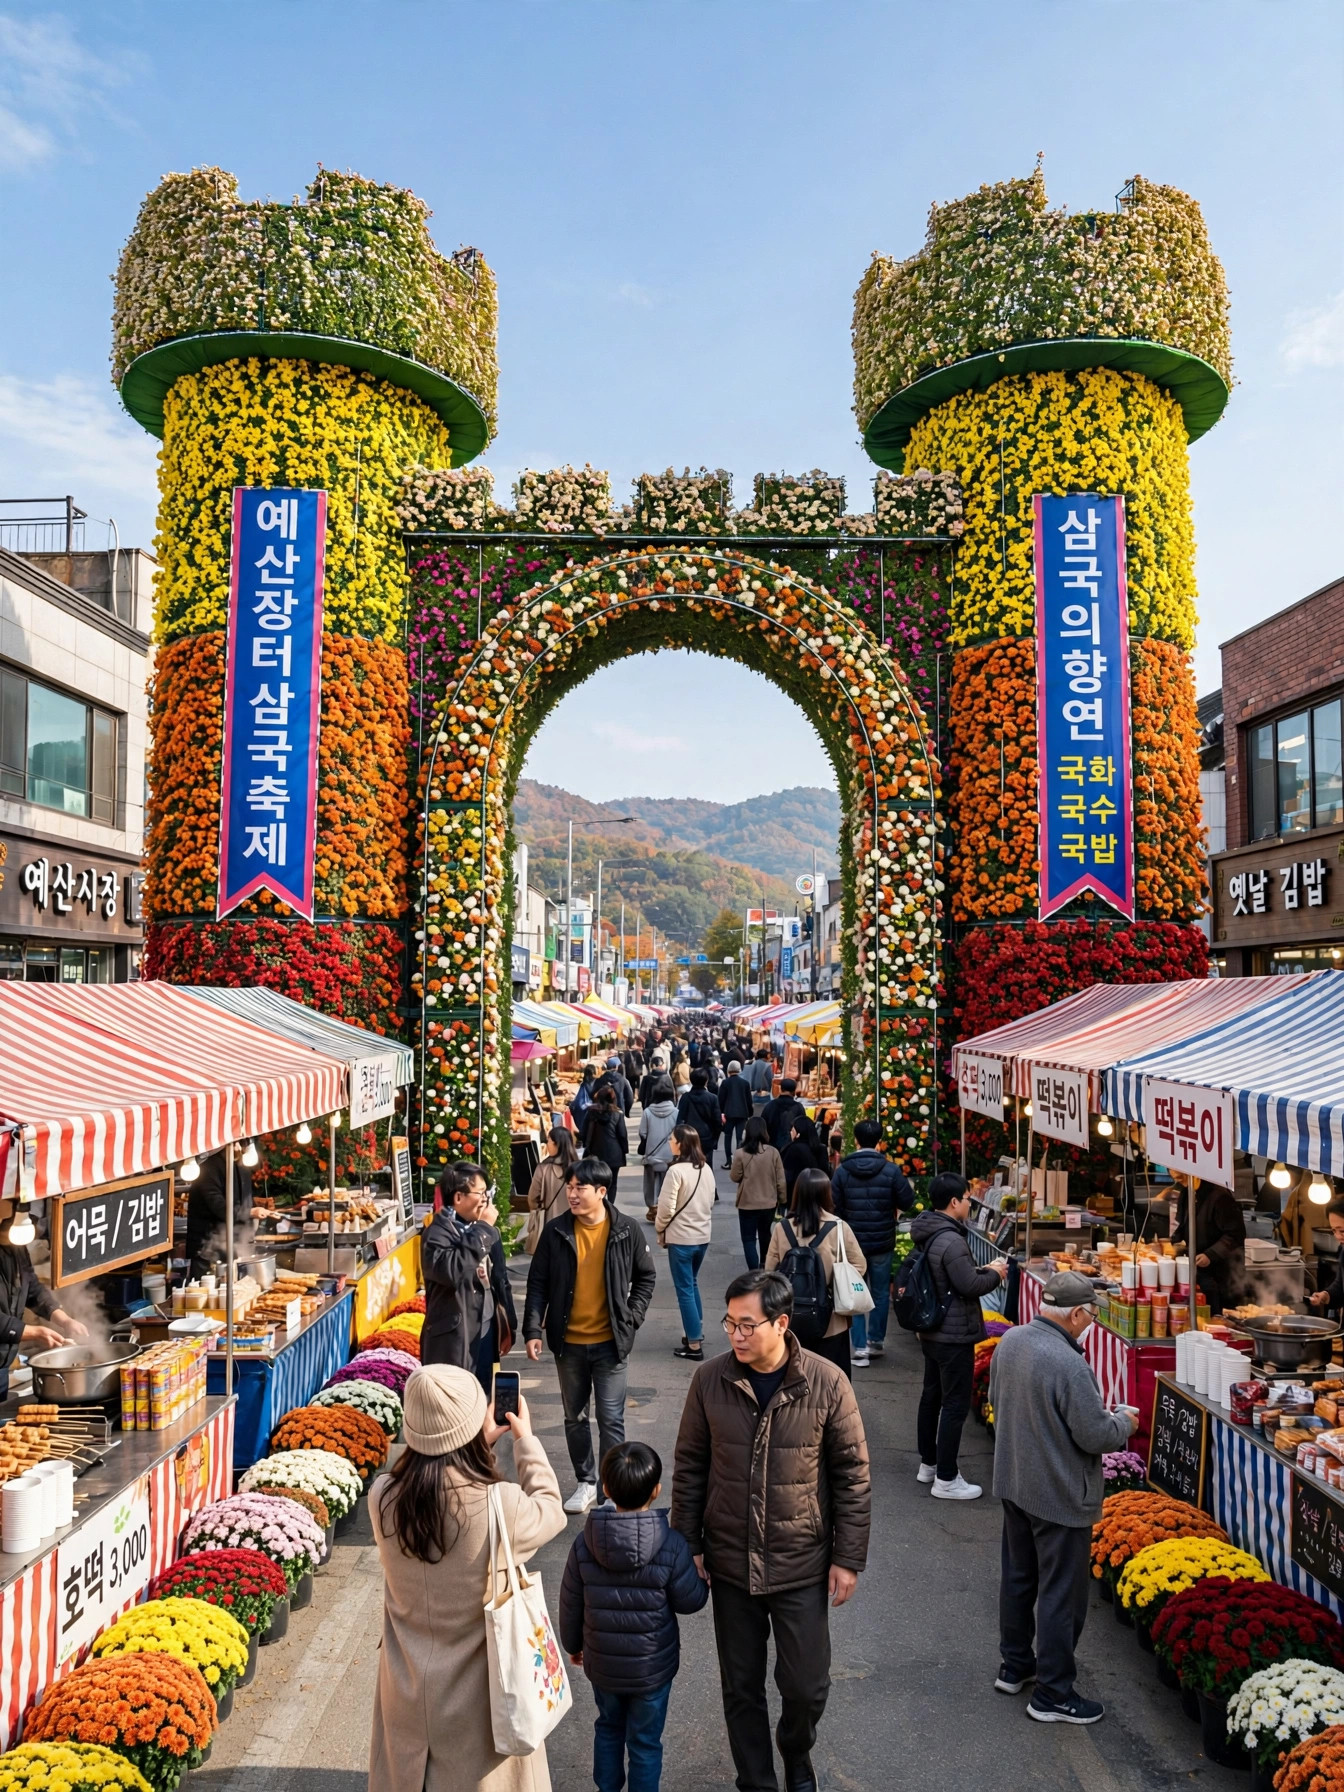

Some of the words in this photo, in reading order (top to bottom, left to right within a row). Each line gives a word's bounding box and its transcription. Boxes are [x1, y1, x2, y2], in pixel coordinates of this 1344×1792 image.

[1057, 508, 1107, 742] 삼국의향연
[1057, 755, 1116, 787] 국화
[1058, 794, 1117, 826] 국수
[1058, 833, 1117, 864] 국밥
[24, 857, 120, 917] 예산시장
[1229, 869, 1268, 916] 옛날
[1279, 858, 1326, 910] 김밥
[1036, 1077, 1082, 1133] 떡볶이
[1154, 1096, 1223, 1169] 떡볶이
[66, 1204, 108, 1260] 어묵
[128, 1189, 164, 1243] 김밥
[62, 1540, 103, 1635] 호떡
[109, 1524, 147, 1588] 3,000
